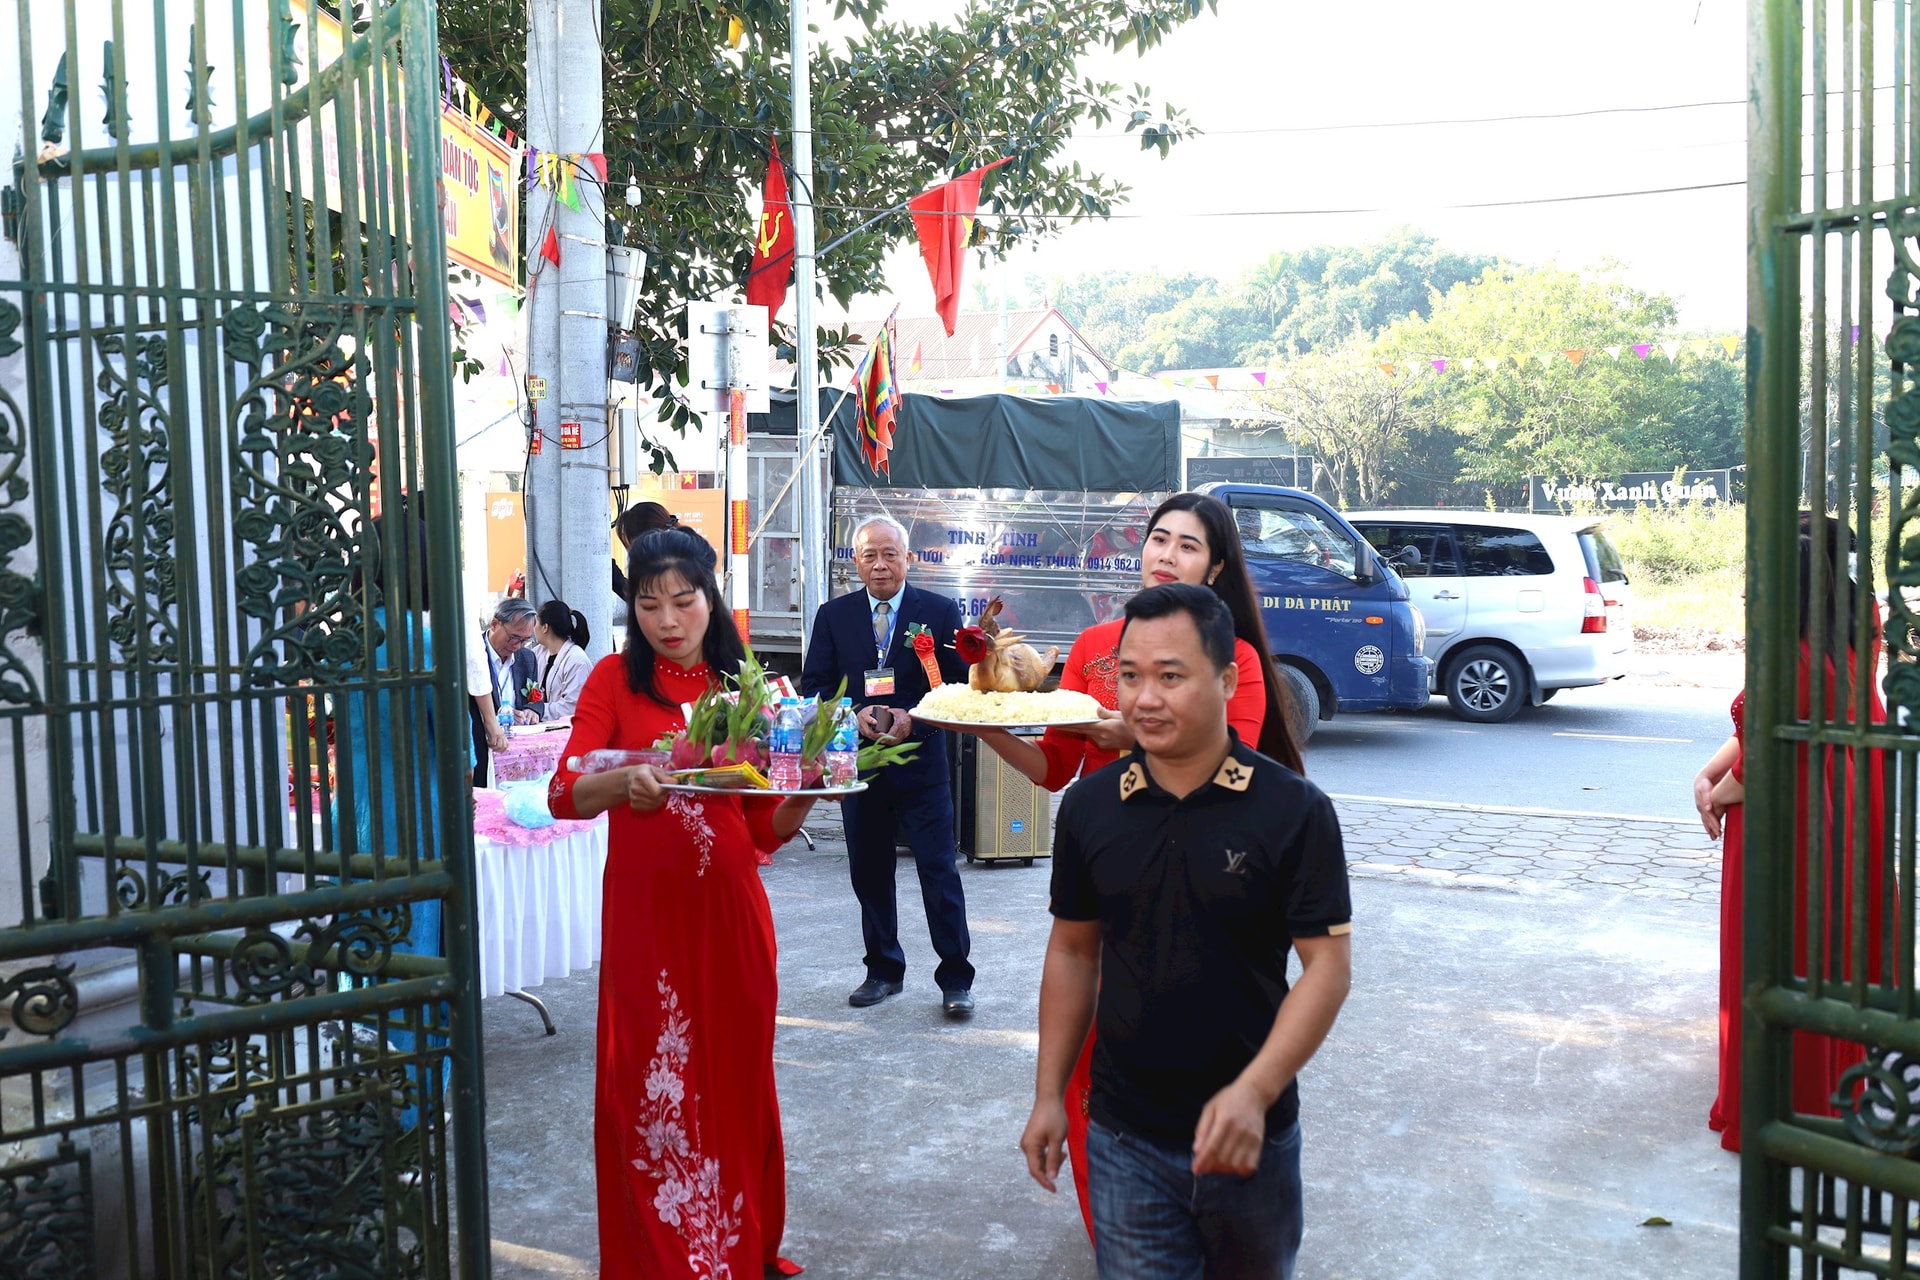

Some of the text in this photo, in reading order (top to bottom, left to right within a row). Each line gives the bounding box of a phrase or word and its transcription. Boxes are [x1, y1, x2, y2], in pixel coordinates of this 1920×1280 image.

[443, 135, 478, 197] DÂN TỘC
[1601, 482, 1656, 501] Xanh
[1087, 557, 1111, 570] 0914
[1114, 558, 1132, 571] 962
[952, 597, 987, 616] 5.66
[1263, 594, 1351, 613] DI ĐÀ PHẬT
